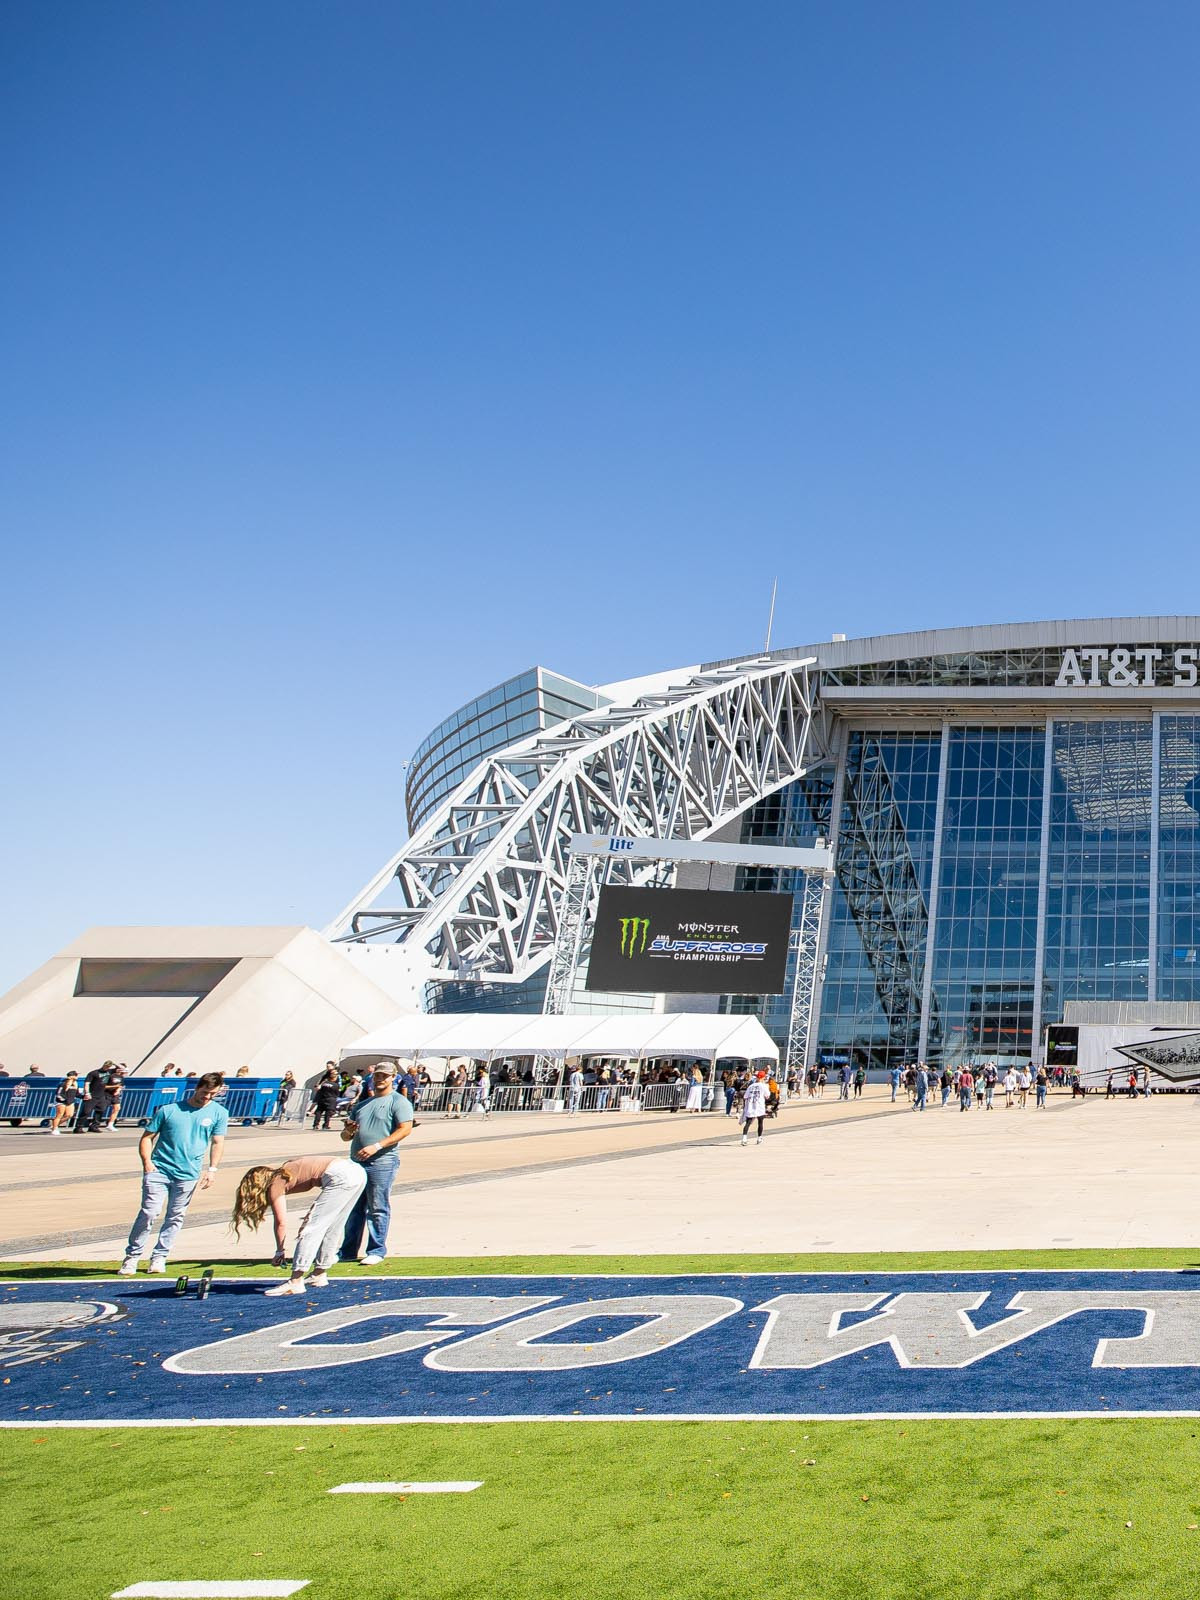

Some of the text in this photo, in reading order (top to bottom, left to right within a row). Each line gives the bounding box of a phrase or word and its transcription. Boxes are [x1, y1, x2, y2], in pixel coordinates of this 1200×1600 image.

[1054, 648, 1162, 687] AT&T
[608, 838, 635, 852] Lite
[678, 922, 740, 934] MONSTER
[649, 939, 767, 954] SUPERCROSS
[673, 953, 741, 962] CHAMPIONSHIP
